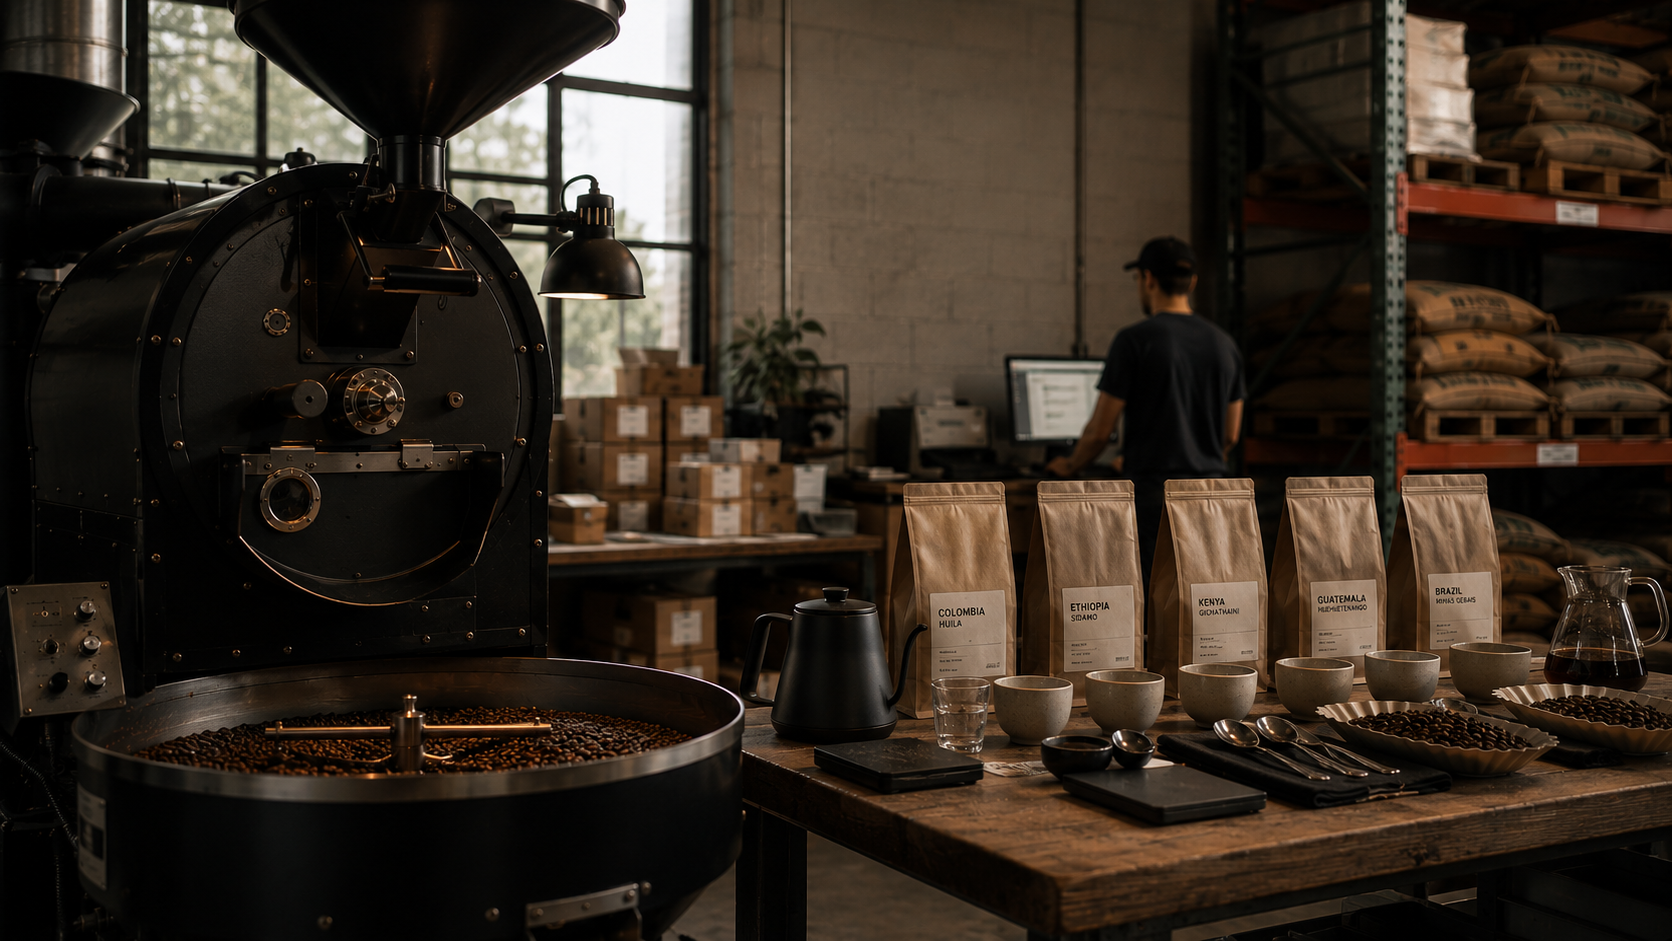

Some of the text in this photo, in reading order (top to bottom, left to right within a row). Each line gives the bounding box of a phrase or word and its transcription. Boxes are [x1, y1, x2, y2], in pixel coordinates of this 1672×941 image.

[1435, 587, 1463, 596] BRAZIL
[1198, 598, 1225, 607] KENYA
[1317, 594, 1367, 604] GUATEMALA
[1070, 602, 1110, 612] ETHIOPIA
[938, 607, 986, 618] COLOMBIA
[938, 620, 963, 629] HUILA
